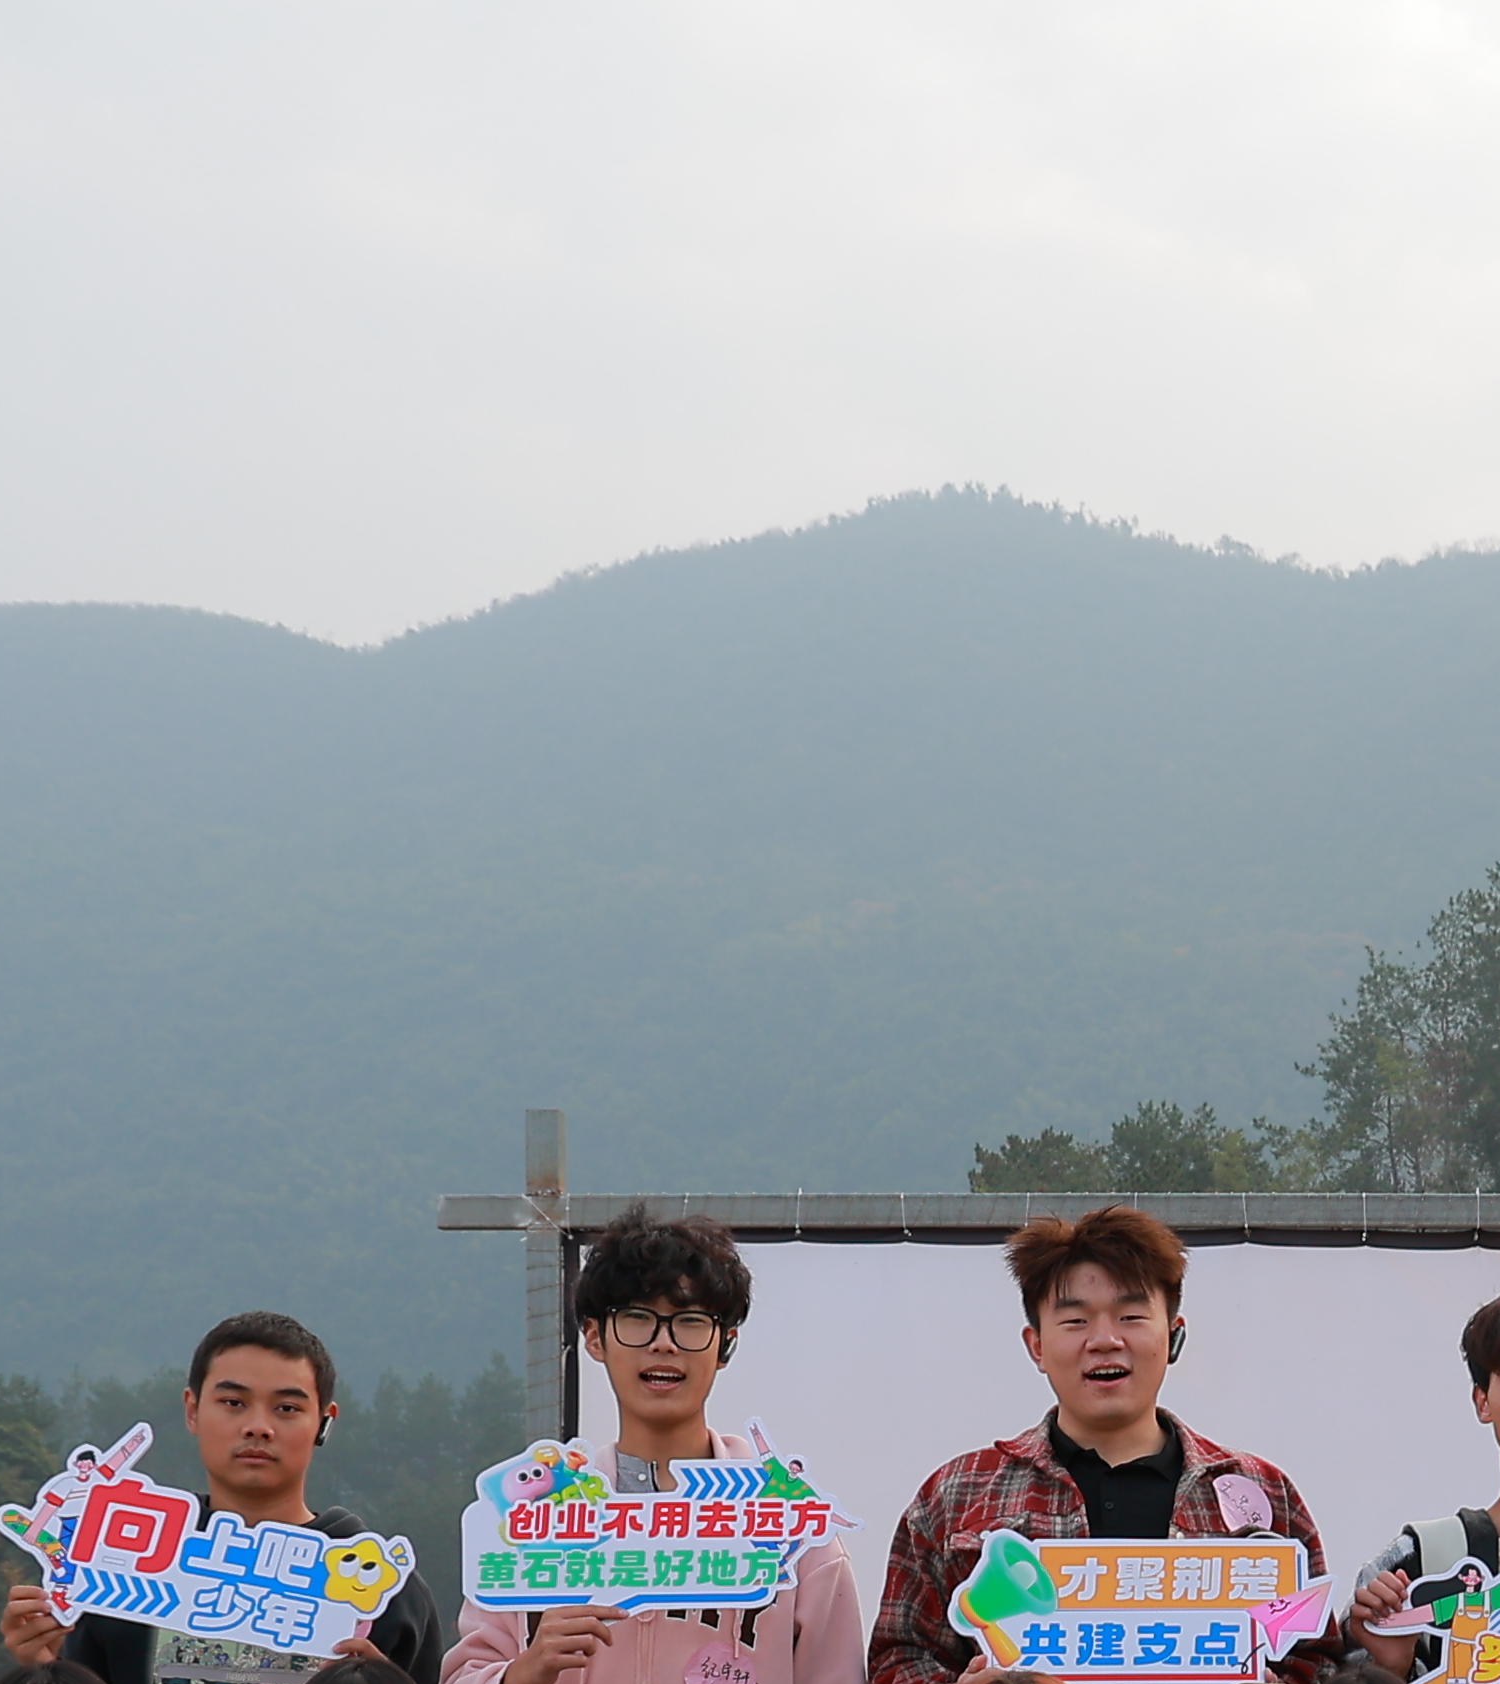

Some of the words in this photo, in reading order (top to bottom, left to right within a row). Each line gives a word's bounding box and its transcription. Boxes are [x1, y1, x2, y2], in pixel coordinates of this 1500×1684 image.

[70, 1479, 322, 1589] 向上吧
[508, 1501, 831, 1539] 创业不用去远方
[478, 1549, 781, 1588] 黄石就是好地方
[1057, 1556, 1280, 1601] 才聚荆楚
[187, 1582, 319, 1647] 少年
[1019, 1622, 1241, 1667] 共建支点
